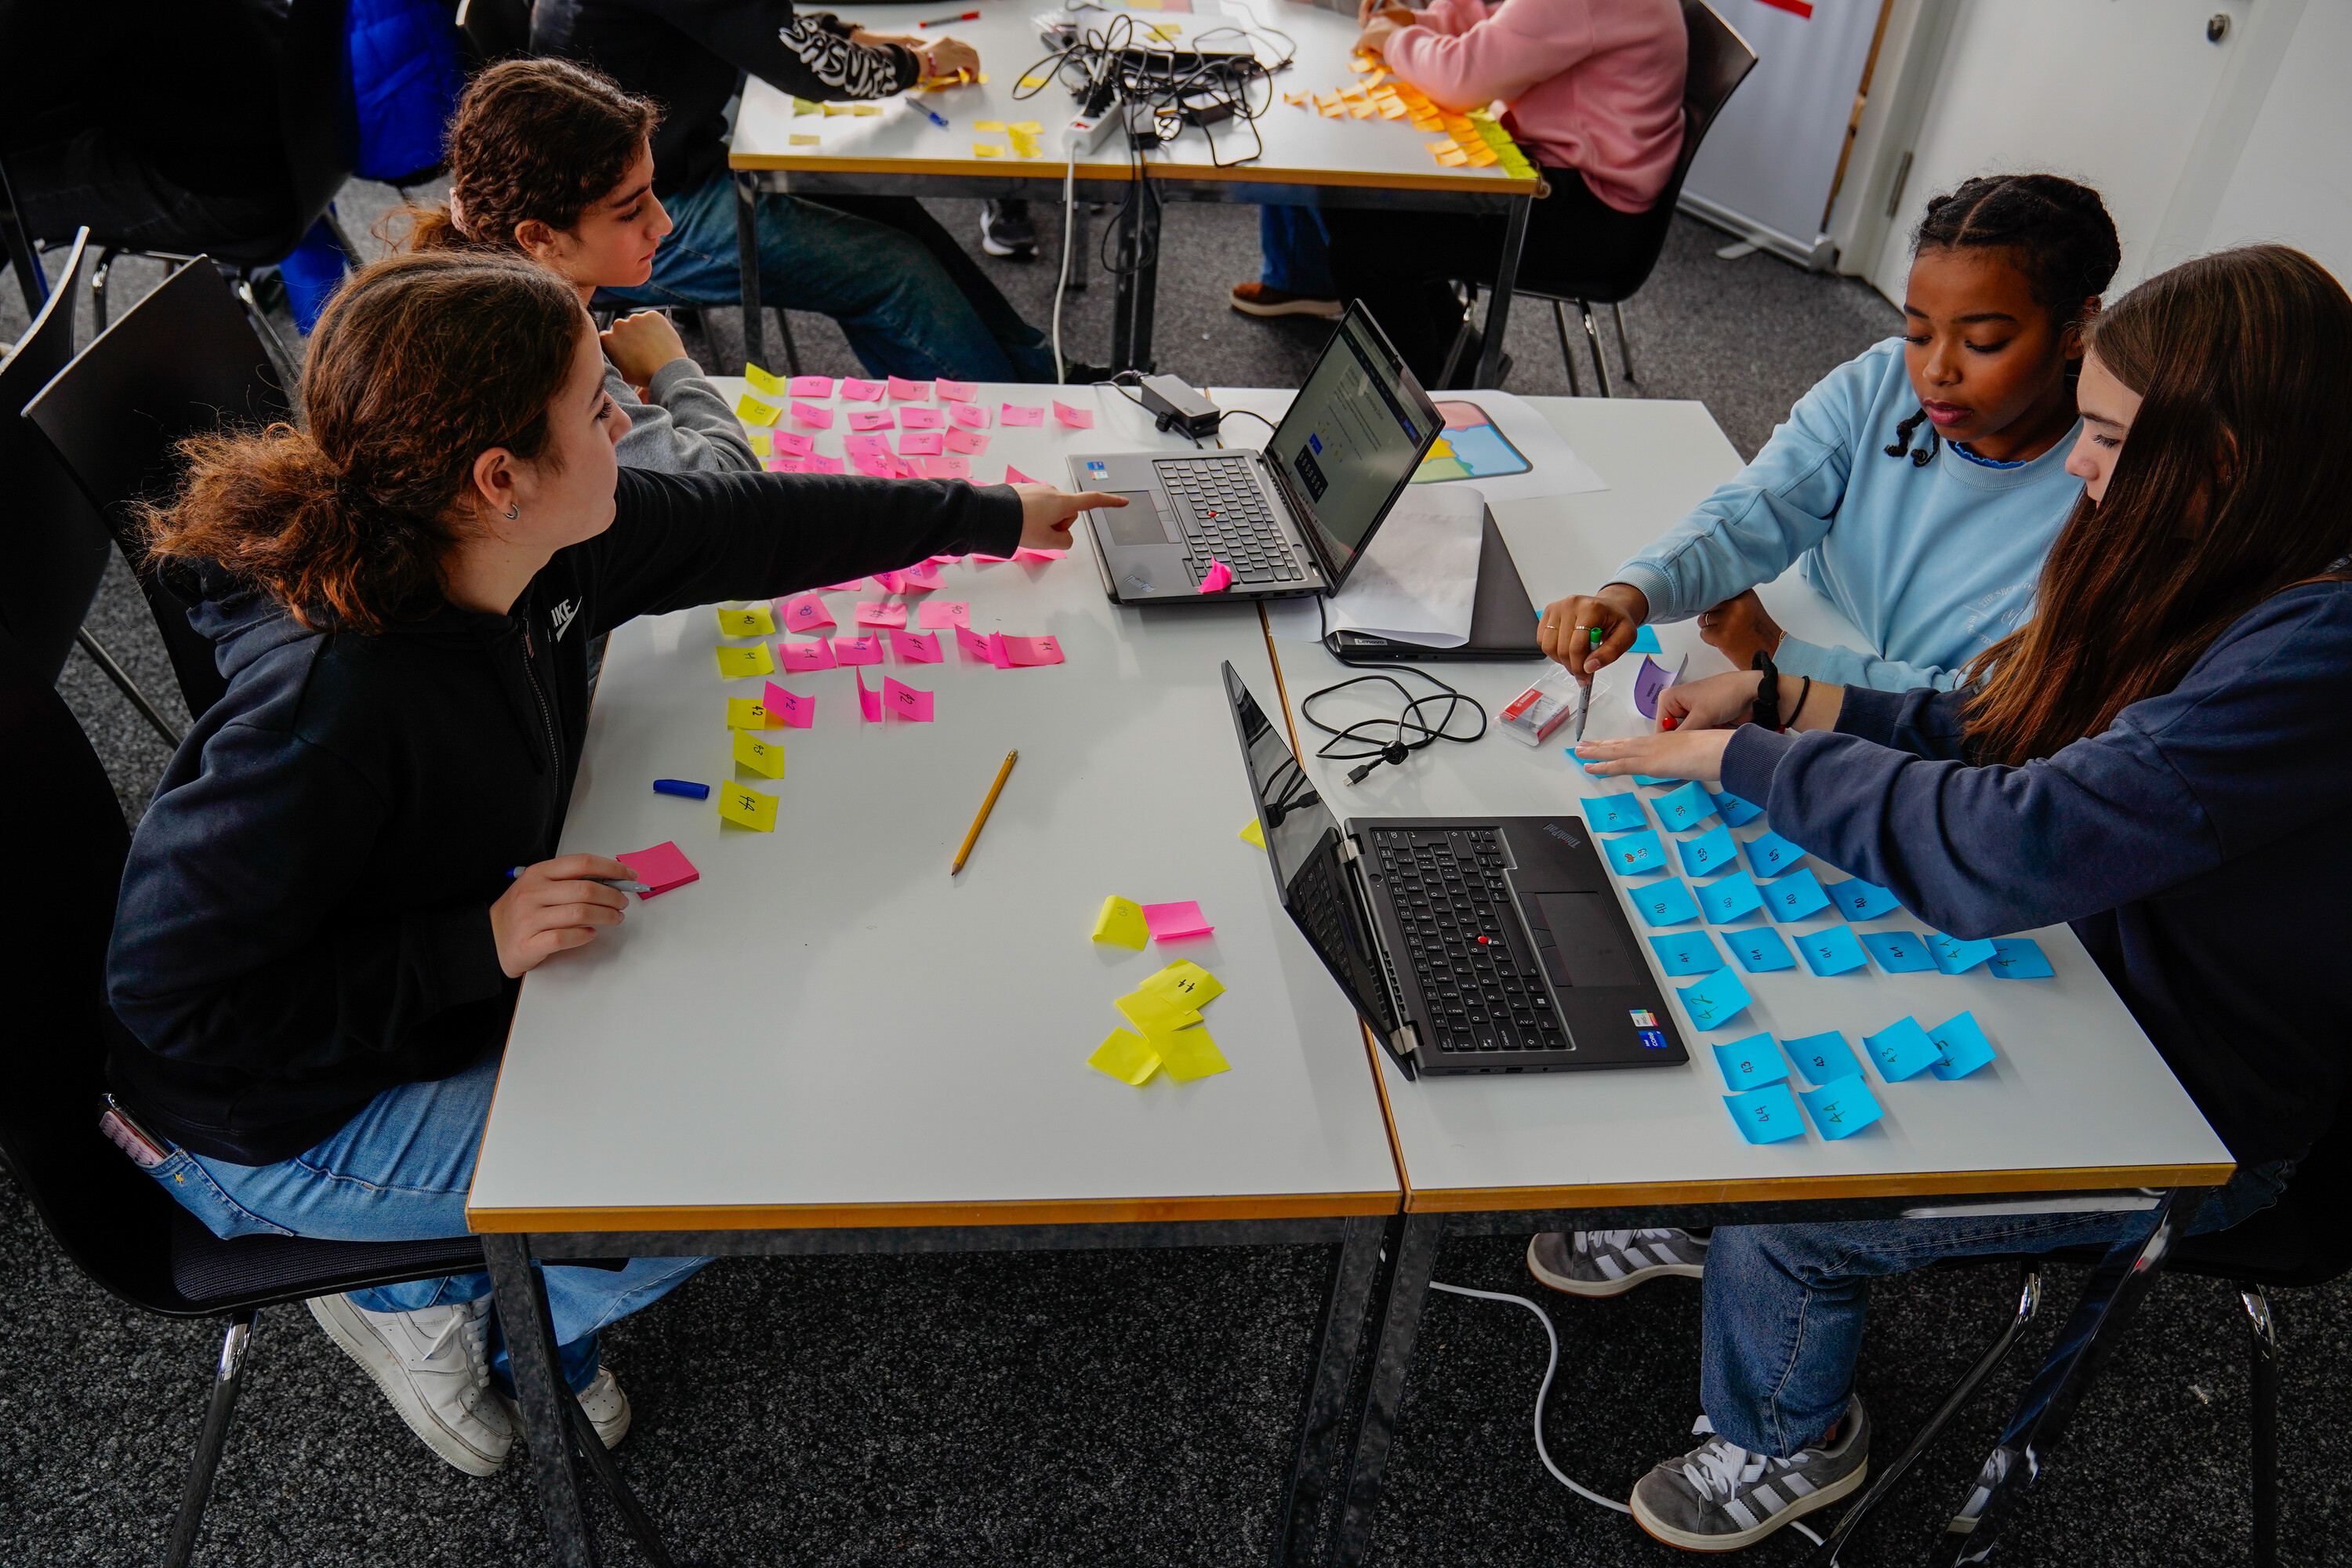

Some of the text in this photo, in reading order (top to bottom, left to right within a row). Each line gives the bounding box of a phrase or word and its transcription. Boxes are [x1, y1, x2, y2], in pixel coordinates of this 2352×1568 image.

[1124, 574, 1156, 593] ThinkPad
[744, 615, 755, 625] 40
[854, 641, 867, 651] 41
[909, 638, 924, 651] 41
[974, 639, 988, 651] 41
[1038, 641, 1053, 651] 41
[803, 648, 818, 659] 41
[786, 696, 797, 710] 42
[898, 691, 915, 705] 42
[752, 706, 764, 717] 42
[753, 743, 764, 755] 43
[739, 795, 755, 811] 44
[1725, 798, 1740, 811] 38
[1675, 805, 1686, 817] 38
[1542, 822, 1581, 849] ThinkPad
[1637, 848, 1648, 858] 39
[1723, 897, 1734, 908] 40
[1786, 894, 1797, 905] 40
[1854, 897, 1867, 909] 40
[1654, 902, 1667, 914] 40
[1679, 953, 1690, 963] 41
[1751, 949, 1762, 960] 41
[1819, 947, 1831, 958] 41
[1889, 946, 1904, 958] 41
[1690, 993, 1719, 1019] 42
[1882, 1047, 1897, 1063] 43
[1740, 1061, 1754, 1073] 43
[1813, 1056, 1824, 1067] 43
[1755, 1105, 1770, 1122] 44
[1823, 1100, 1846, 1123] 44
